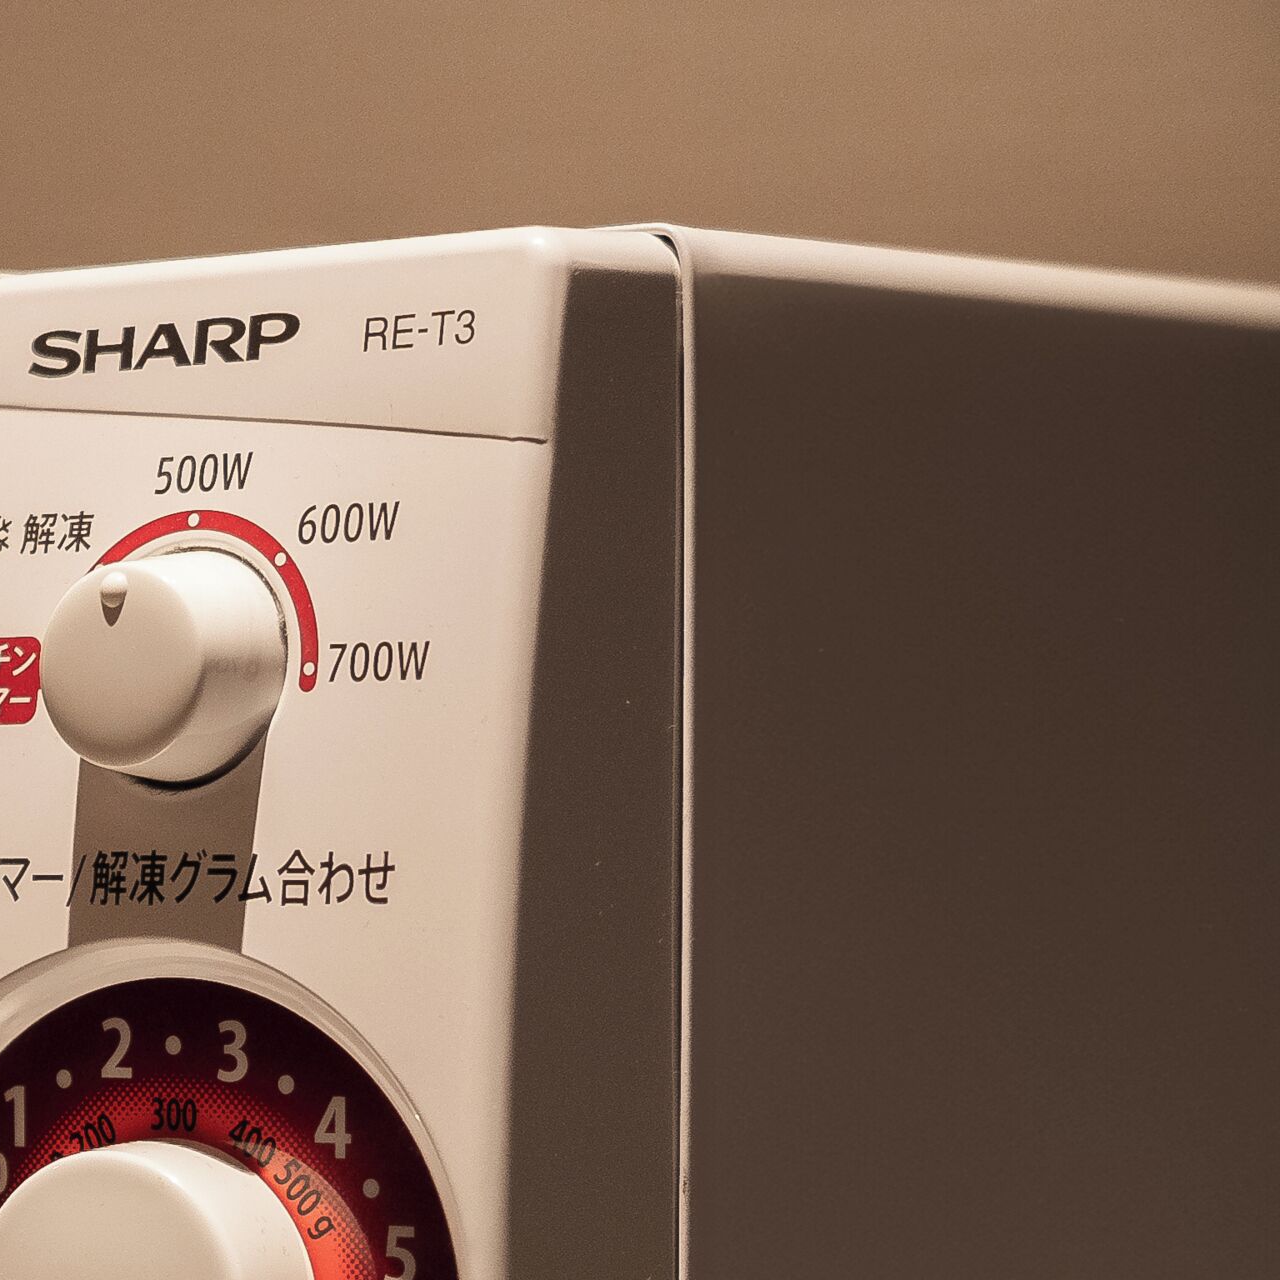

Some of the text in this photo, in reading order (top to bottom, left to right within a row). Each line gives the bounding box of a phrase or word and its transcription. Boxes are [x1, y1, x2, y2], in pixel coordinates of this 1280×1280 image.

[28, 310, 477, 378] SHARP RE-T3
[154, 451, 253, 495] 500W
[20, 511, 95, 555] 解凍
[297, 501, 400, 544] 600W
[327, 640, 430, 683] 700W
[100, 1017, 133, 1079] 2
[217, 1020, 249, 1083] 3
[4, 1085, 27, 1147] 1
[150, 1097, 197, 1132] 300
[314, 1096, 352, 1159] 4
[228, 1119, 277, 1168] 400
